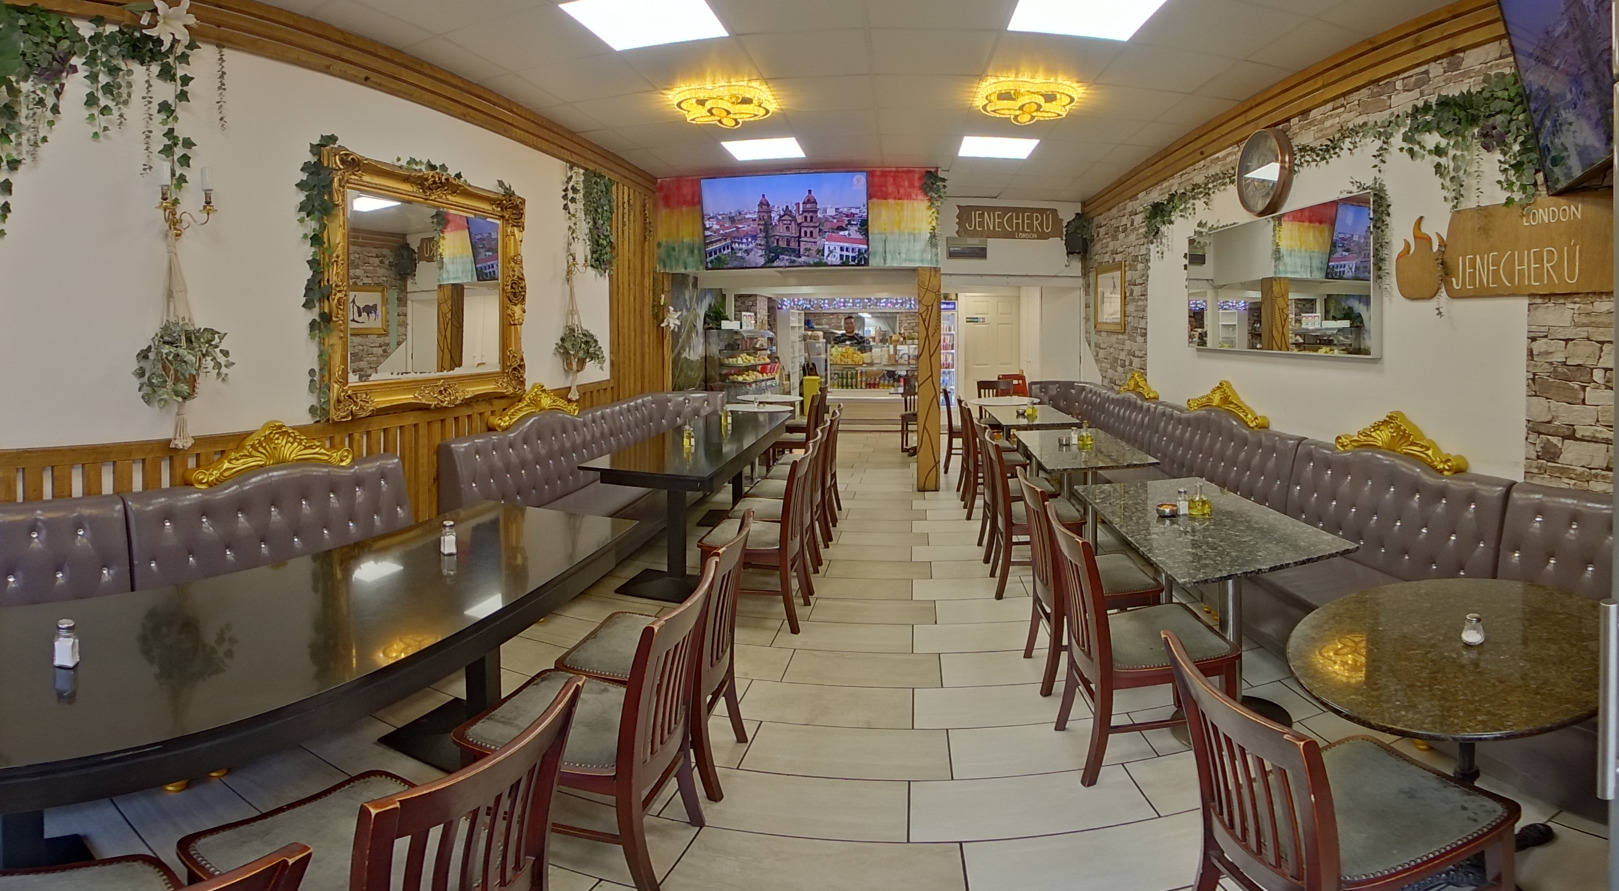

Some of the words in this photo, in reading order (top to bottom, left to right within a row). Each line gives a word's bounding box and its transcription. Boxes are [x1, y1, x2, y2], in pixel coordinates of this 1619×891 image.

[966, 210, 1052, 233] JENECHERÚ
[1523, 203, 1582, 226] LONDON
[1452, 239, 1580, 290] JENECHERÚ
